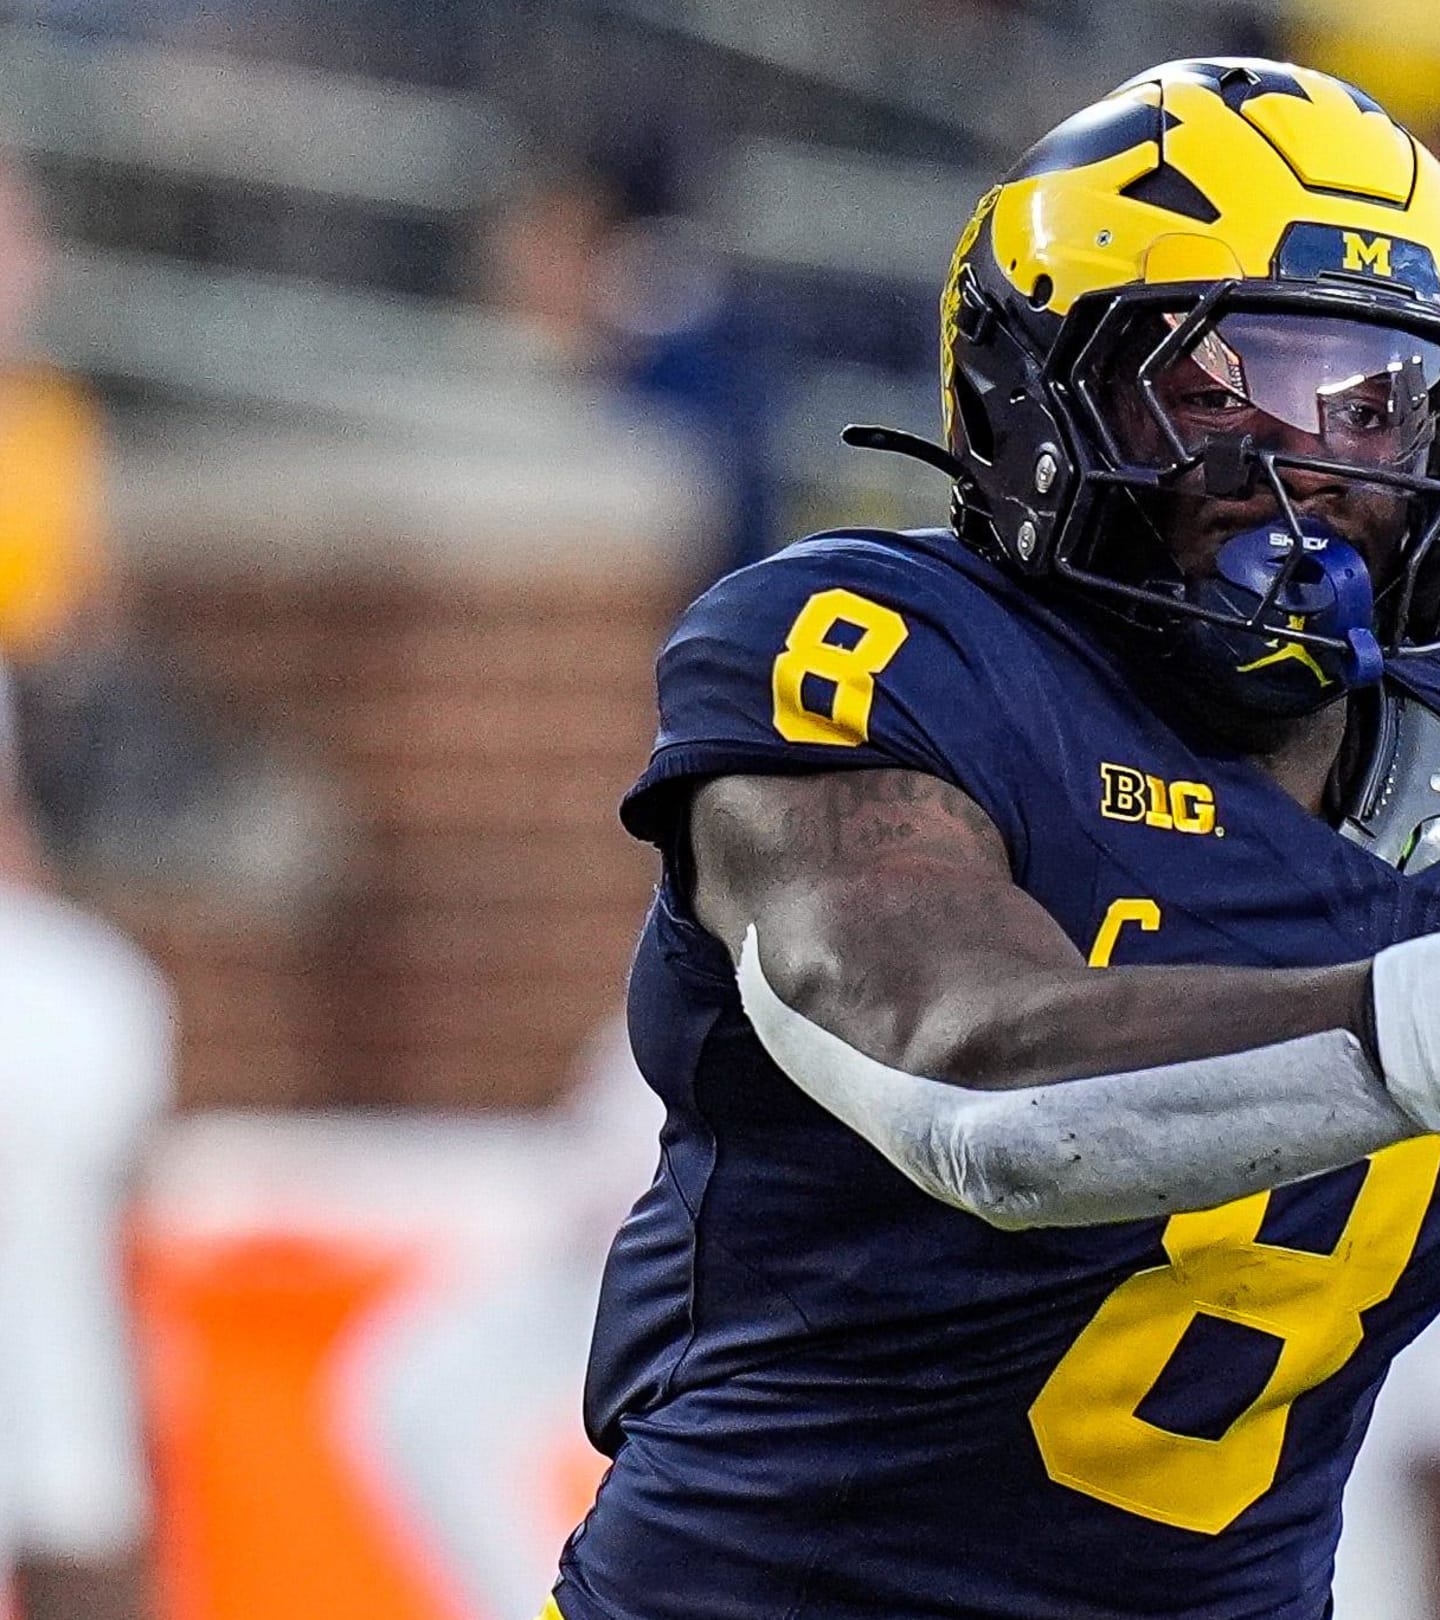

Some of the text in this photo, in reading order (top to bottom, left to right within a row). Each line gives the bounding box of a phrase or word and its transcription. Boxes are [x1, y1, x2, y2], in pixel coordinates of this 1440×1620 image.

[1343, 231, 1392, 278] M
[1269, 532, 1329, 551] SHCK
[772, 587, 911, 748] 8
